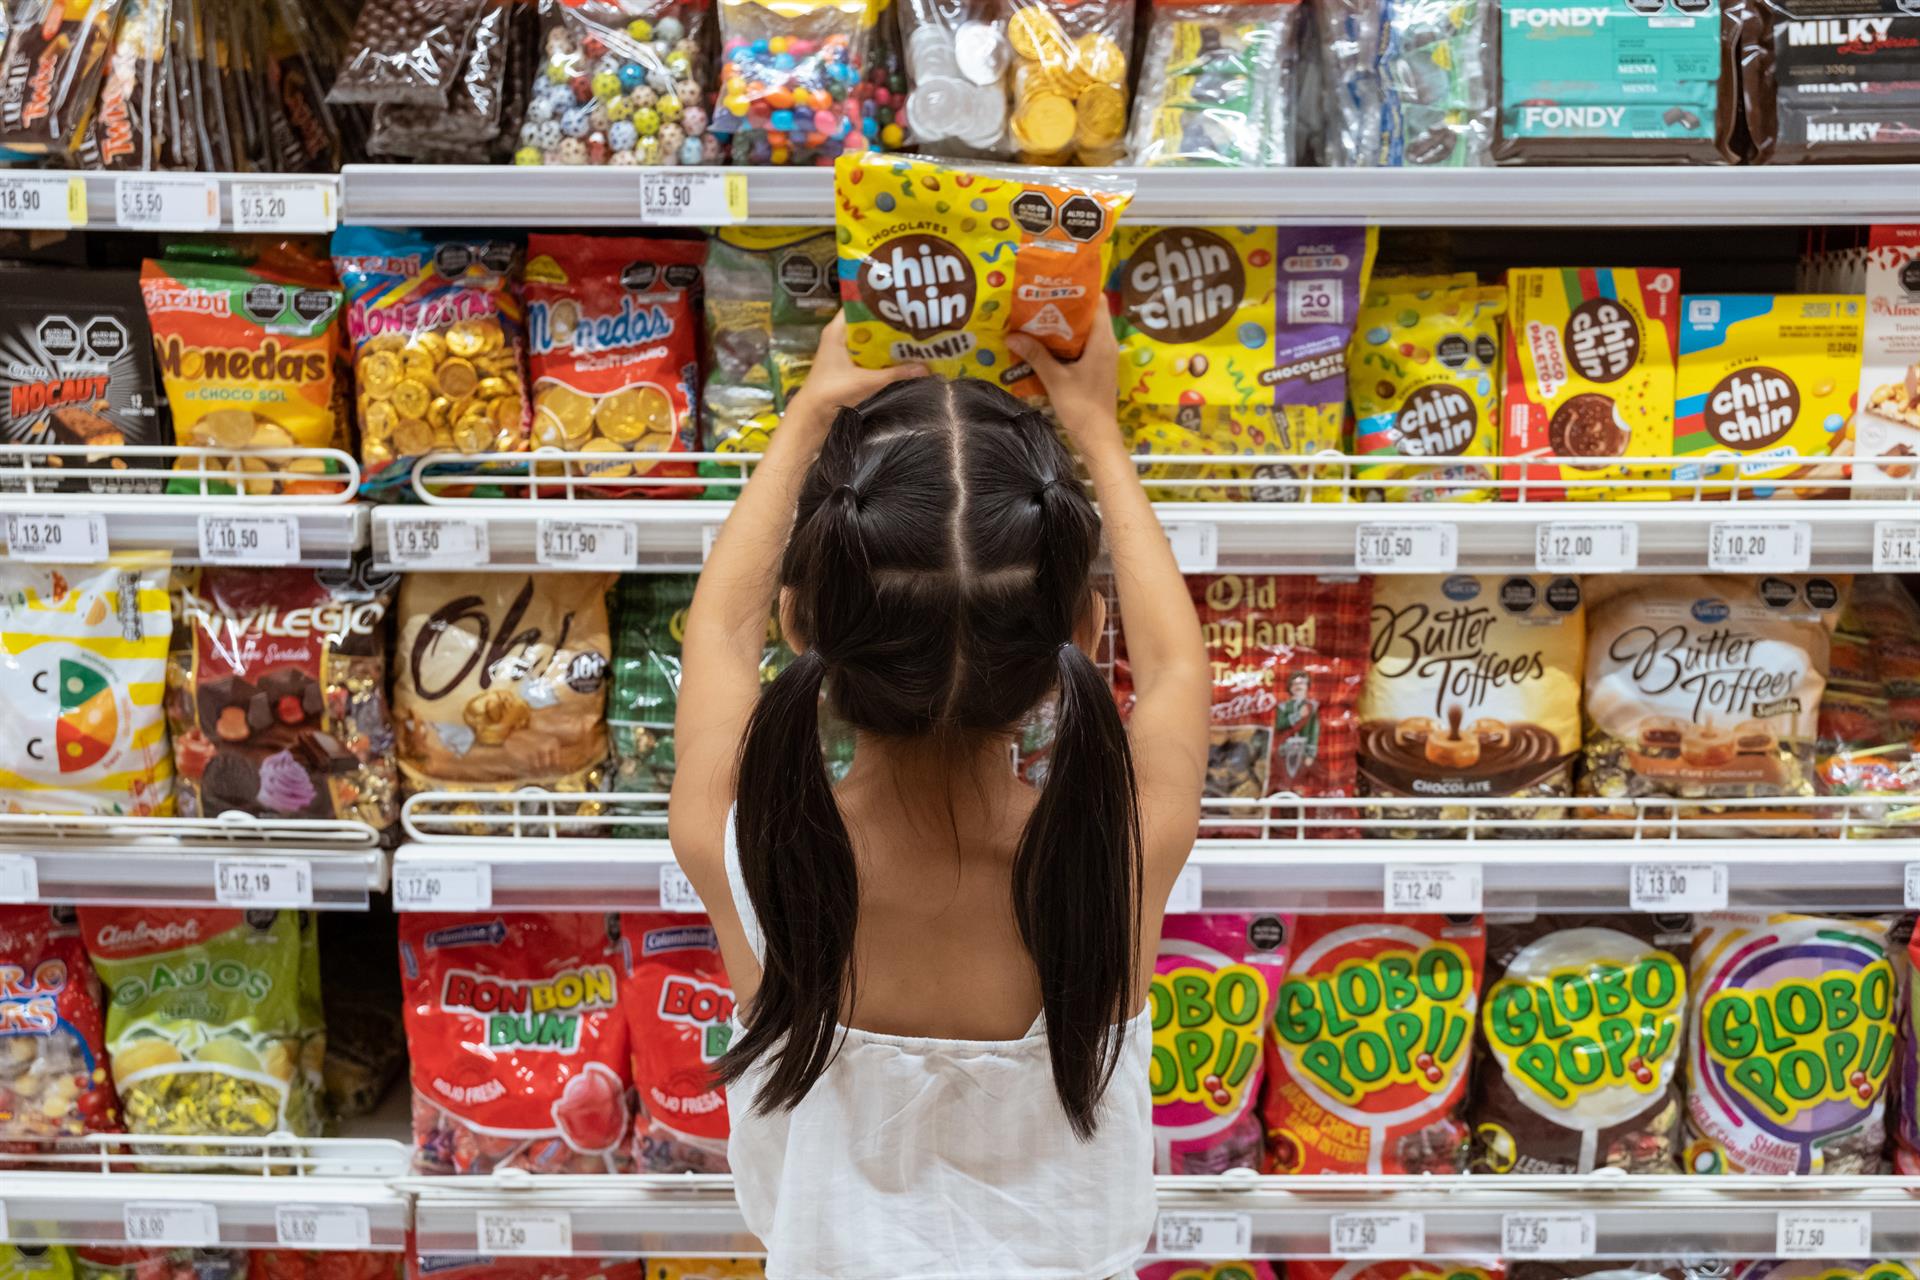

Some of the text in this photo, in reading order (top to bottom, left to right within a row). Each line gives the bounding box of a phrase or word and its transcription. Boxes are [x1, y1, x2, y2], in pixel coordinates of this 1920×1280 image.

[1509, 8, 1610, 28] FONDY
[1788, 18, 1894, 46] MILKY
[1618, 64, 1657, 74] MENTA
[1525, 106, 1626, 129] FONDY
[1806, 122, 1881, 141] MILKY
[1066, 210, 1085, 218] ALTO
[866, 221, 949, 247] CHOCOLATES
[1297, 244, 1335, 254] PACK
[867, 243, 966, 291] chin
[1131, 236, 1231, 292] chin
[1289, 256, 1342, 268] FIESTA
[878, 285, 967, 330] chin
[1024, 288, 1079, 298] FIESTA
[1140, 276, 1234, 330] chin
[1302, 294, 1330, 308] 20
[153, 335, 327, 382] Monedas
[1544, 329, 1566, 381] CHOCO
[1572, 312, 1608, 378] chin
[1598, 304, 1635, 375] chin
[1263, 353, 1345, 383] CHOCOLATE
[1309, 365, 1346, 382] REAL
[11, 375, 110, 420] NOCAUT
[200, 387, 254, 400] CHOCO
[259, 388, 289, 402] SOL
[1400, 389, 1470, 433] chin
[1712, 372, 1791, 416] chin
[1405, 417, 1473, 456] chin
[1718, 403, 1793, 443] chin
[1206, 575, 1277, 611] Old
[1202, 614, 1316, 658] ngland
[1370, 603, 1497, 679] Butter
[1608, 625, 1762, 696] Butter
[1418, 649, 1544, 719] Toffees
[1680, 667, 1798, 724] Toffees
[1412, 778, 1491, 794] CHOCOLATE
[112, 961, 273, 1009] GAJOS
[1275, 947, 1465, 1044] GLOBO
[1491, 957, 1676, 1047] GLOBO
[489, 1015, 581, 1048] BUM
[1708, 968, 1891, 1060] GLOBO
[1151, 1029, 1257, 1104] OP!!
[465, 1078, 507, 1105] FRESA
[680, 1090, 725, 1114] FRESA
[1319, 1113, 1371, 1149] CHICLE
[1749, 1133, 1799, 1162] SHAKE
